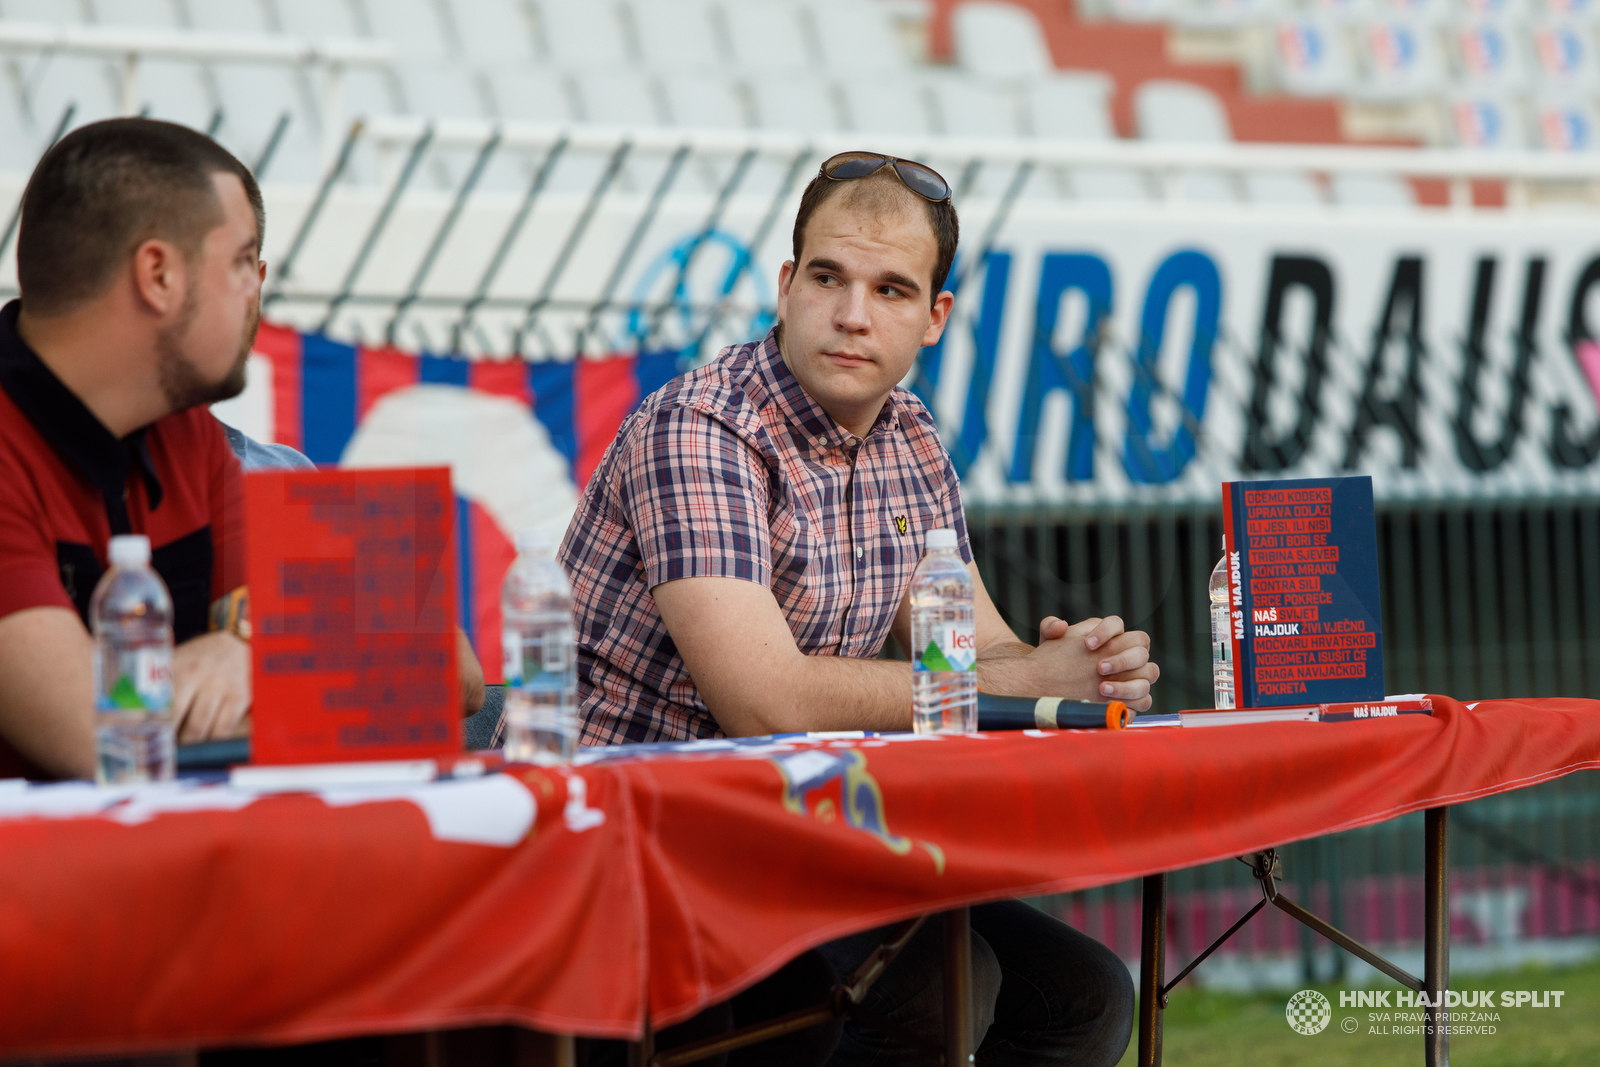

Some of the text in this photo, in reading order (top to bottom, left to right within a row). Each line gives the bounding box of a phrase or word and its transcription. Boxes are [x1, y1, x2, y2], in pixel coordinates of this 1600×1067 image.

[1288, 490, 1330, 502] KODEKS
[1248, 505, 1331, 519] UPRAVA ODLAZI
[1249, 522, 1261, 533] ILI
[1293, 521, 1304, 532] ILI
[1308, 520, 1329, 531] NISI
[1286, 535, 1311, 547] BORI
[1313, 534, 1327, 546] SE
[1252, 548, 1337, 562] TRIBINA SJEVER
[1252, 563, 1336, 577] KONTRA MRAKU
[1253, 578, 1318, 592] KONTRA SILI
[1230, 551, 1244, 640] NAŠ HAJDUK
[1253, 594, 1282, 607] SRCE
[1254, 607, 1316, 622] NAŠ SVIJET
[1255, 618, 1365, 637] HAJDUK ŽIVI VJEČNO
[1311, 635, 1373, 648] HRVATSKOG
[1257, 652, 1316, 666] NOGOMETA
[1257, 668, 1294, 680] SNAGA
[1258, 682, 1307, 695] POKRETA
[1354, 705, 1398, 718] NAŠ HAJDUK
